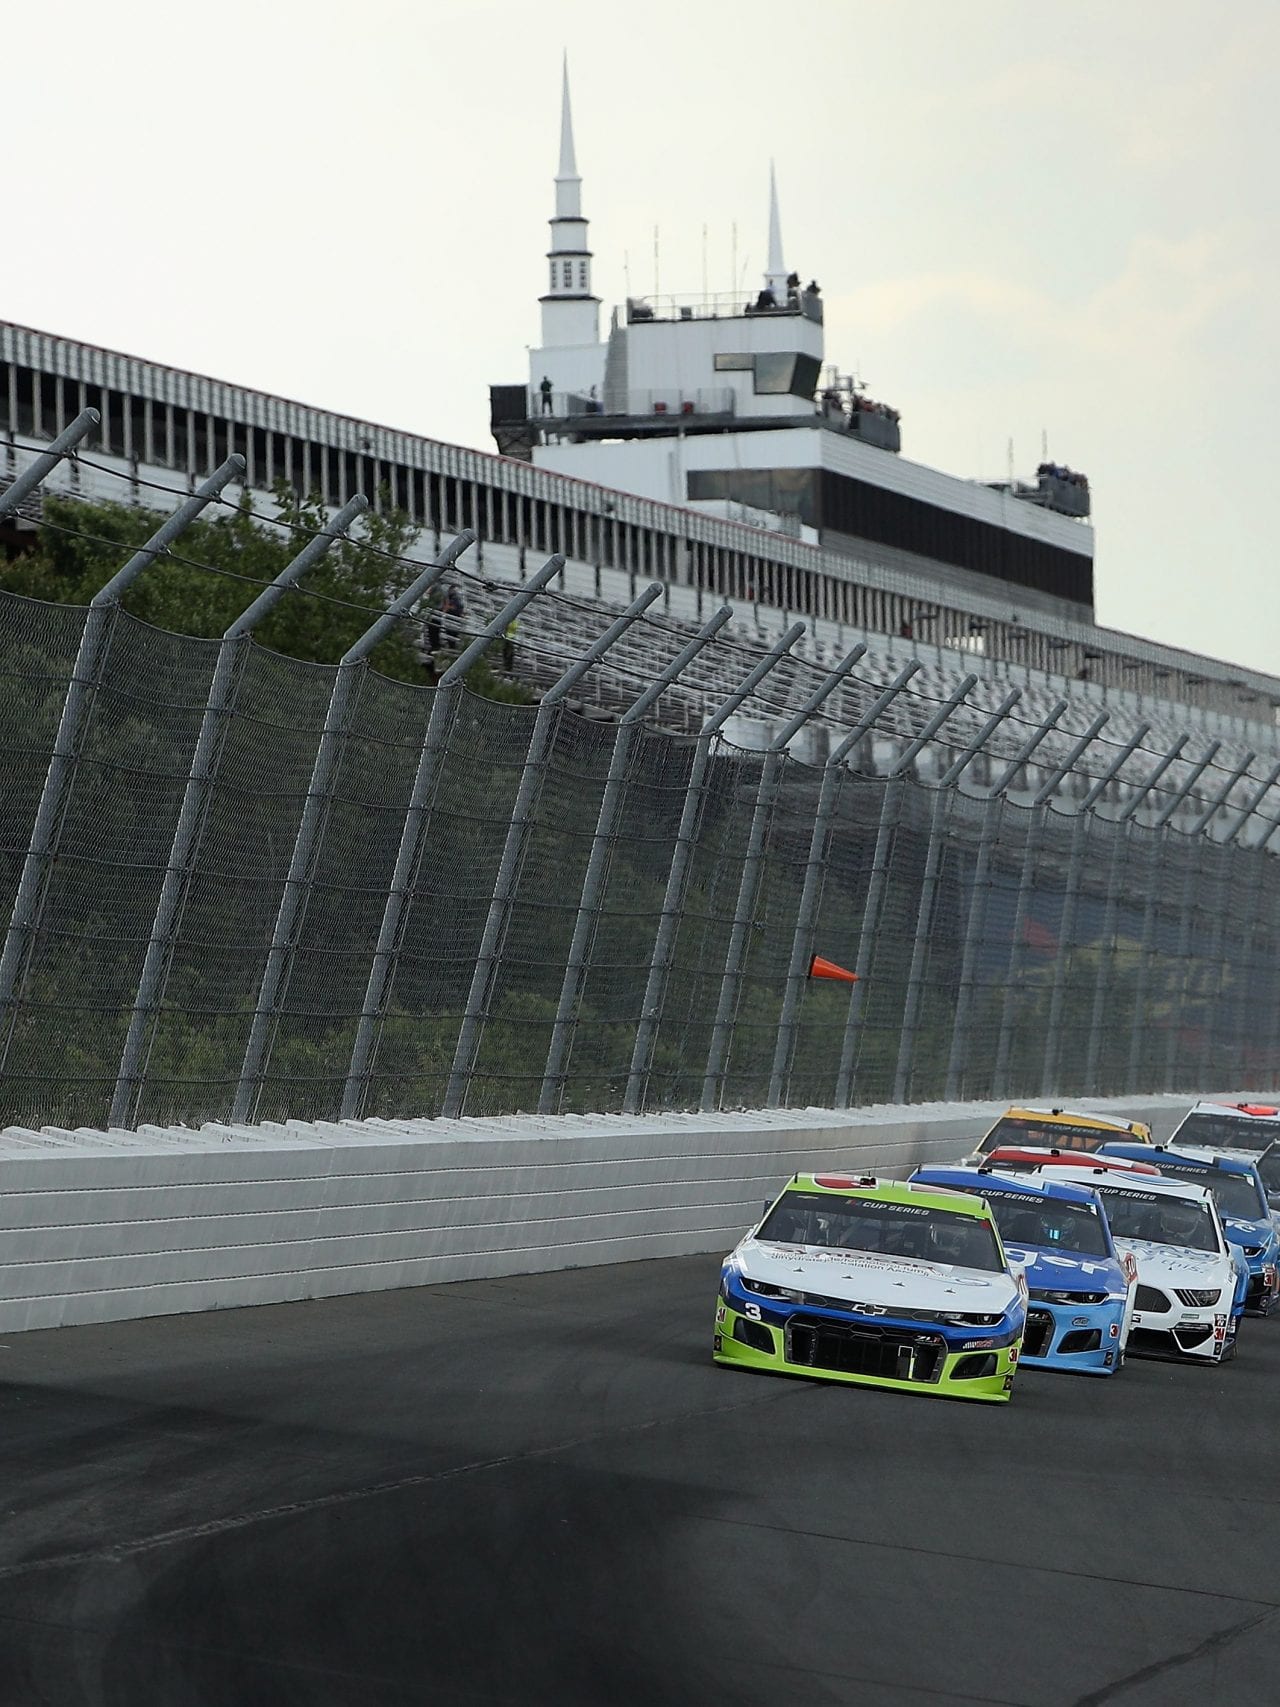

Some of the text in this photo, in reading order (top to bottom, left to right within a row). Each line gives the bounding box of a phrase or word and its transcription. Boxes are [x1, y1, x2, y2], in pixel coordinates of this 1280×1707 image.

[1176, 1165, 1208, 1174] SERIES
[980, 1189, 1044, 1203] CUP SERIES
[1098, 1187, 1157, 1200] CUP SERIES
[862, 1201, 930, 1216] CUP SERIES
[745, 1302, 761, 1320] 3
